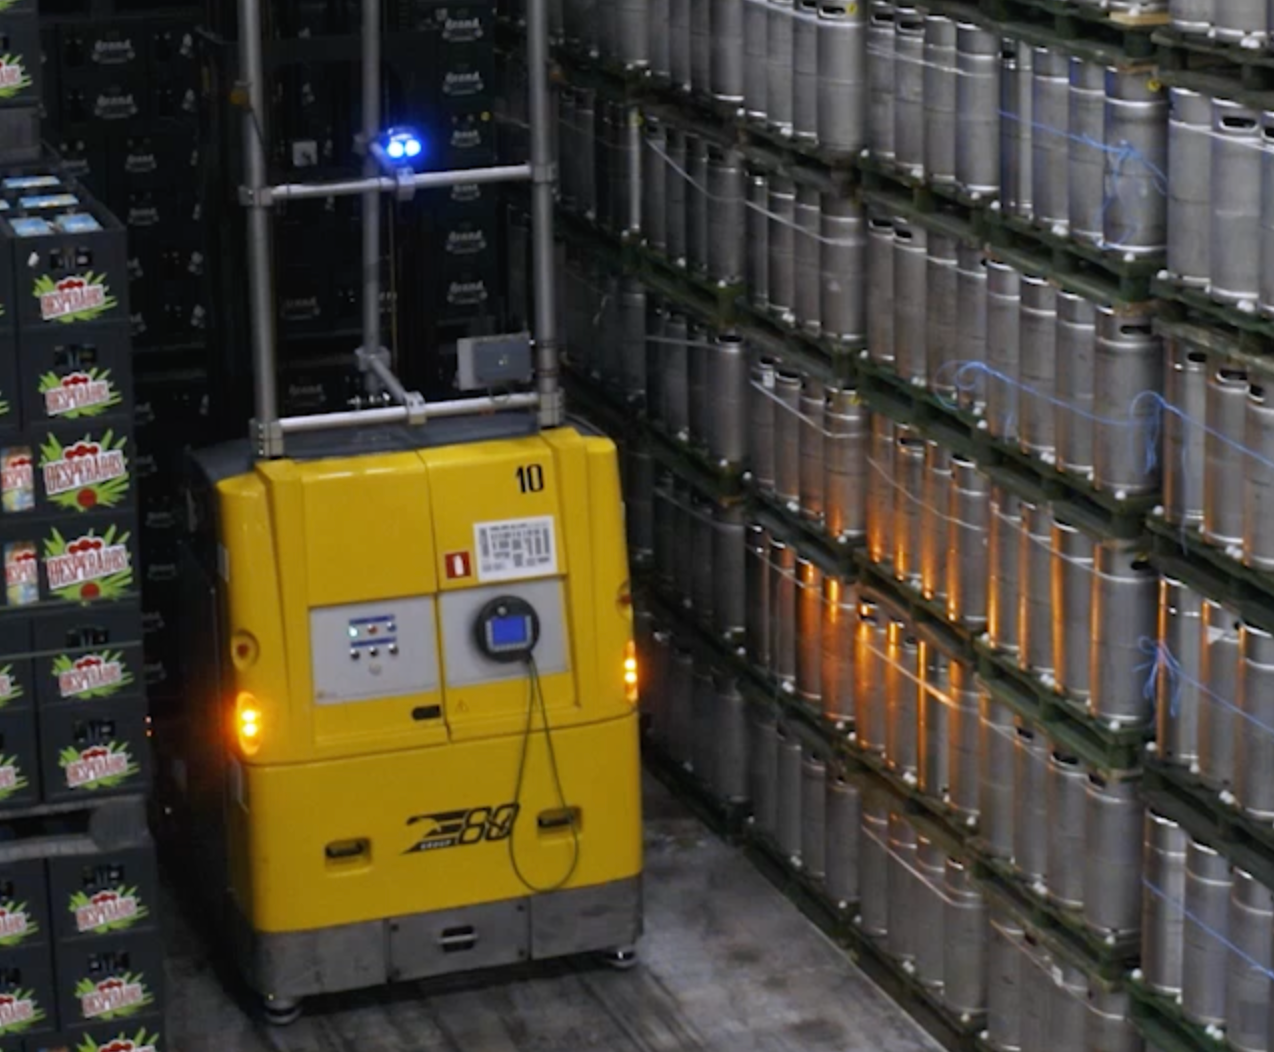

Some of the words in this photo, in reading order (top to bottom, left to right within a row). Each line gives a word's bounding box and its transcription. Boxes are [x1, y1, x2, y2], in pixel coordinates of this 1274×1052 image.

[43, 452, 125, 492] DESPERADOS
[515, 464, 544, 494] 10
[46, 546, 128, 586] DESPERADOS
